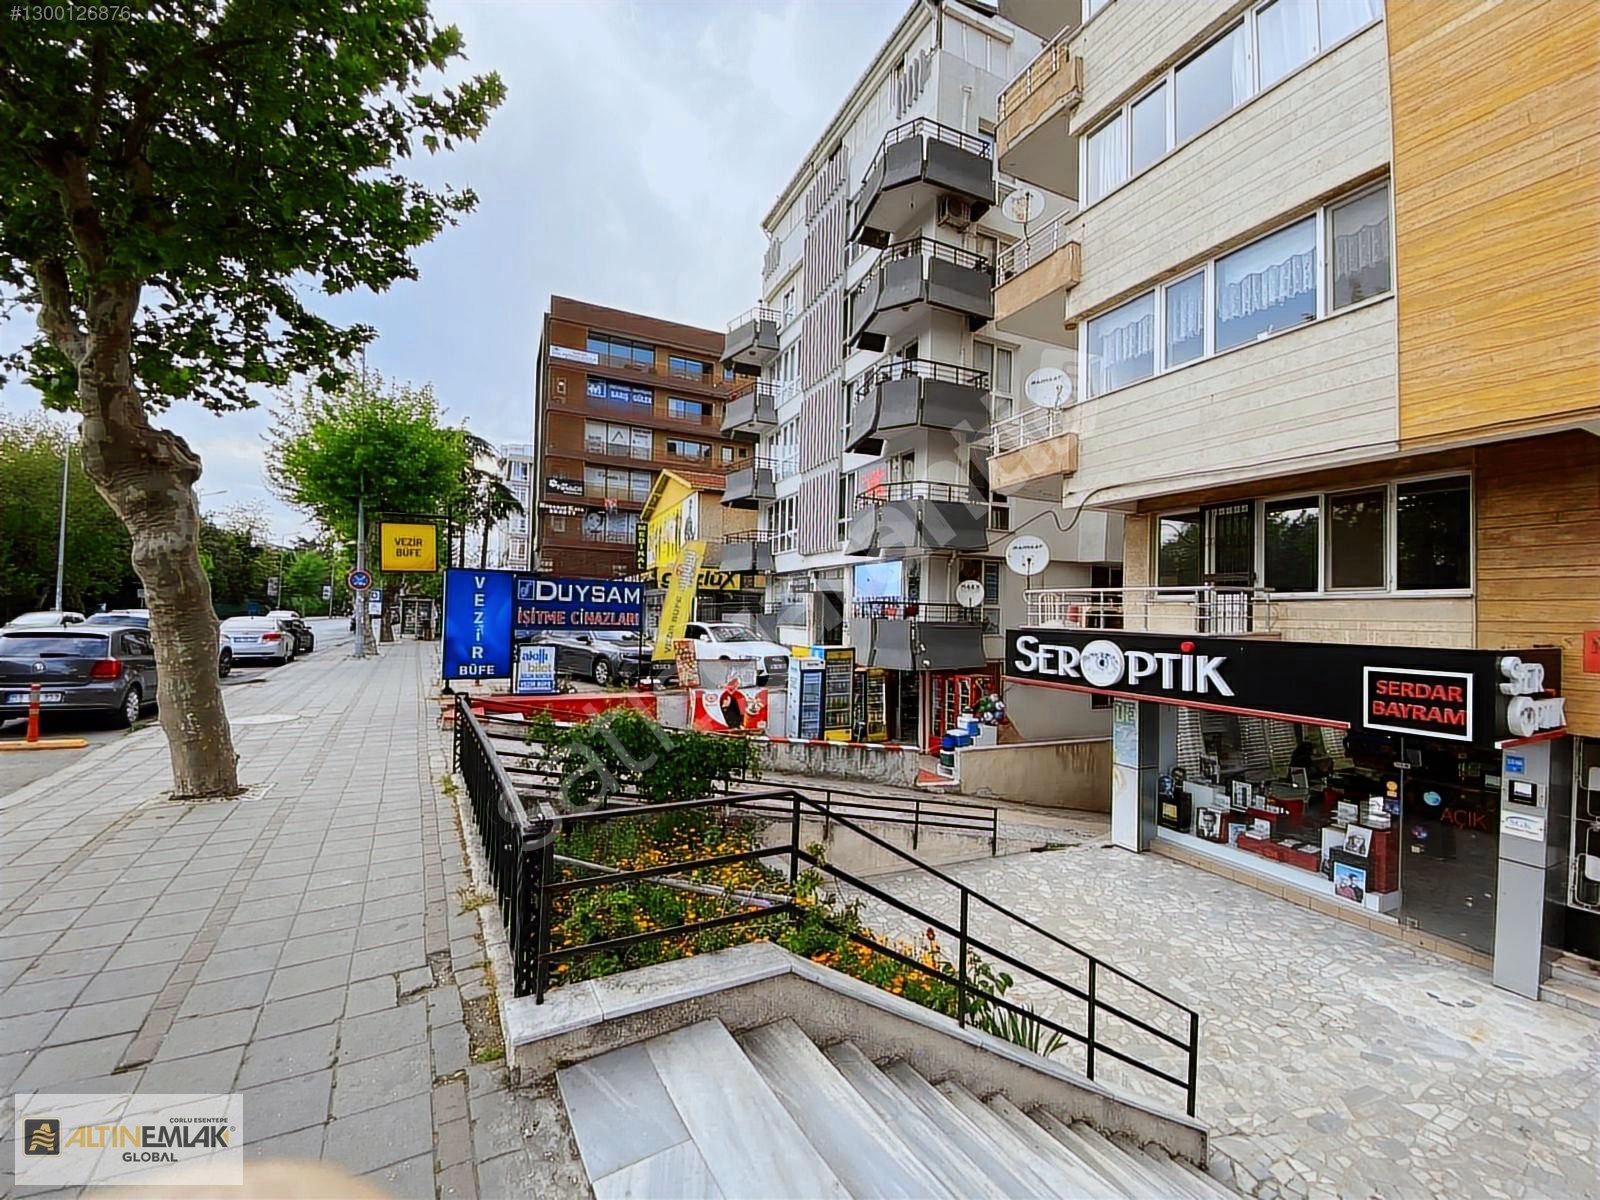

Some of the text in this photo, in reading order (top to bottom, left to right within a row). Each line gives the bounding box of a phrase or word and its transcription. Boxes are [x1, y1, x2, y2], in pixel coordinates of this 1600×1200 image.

[394, 537, 422, 547] VEZİR
[396, 548, 422, 557] BÜFE
[535, 581, 640, 605] DUYSAM
[518, 606, 566, 627] İŞİTME
[570, 608, 640, 626] CİHAZLARI
[459, 663, 495, 676] BÜFE
[1376, 680, 1464, 703] SERDAR
[1372, 701, 1466, 727] BAYRAM
[1440, 807, 1488, 830] AÇIK
